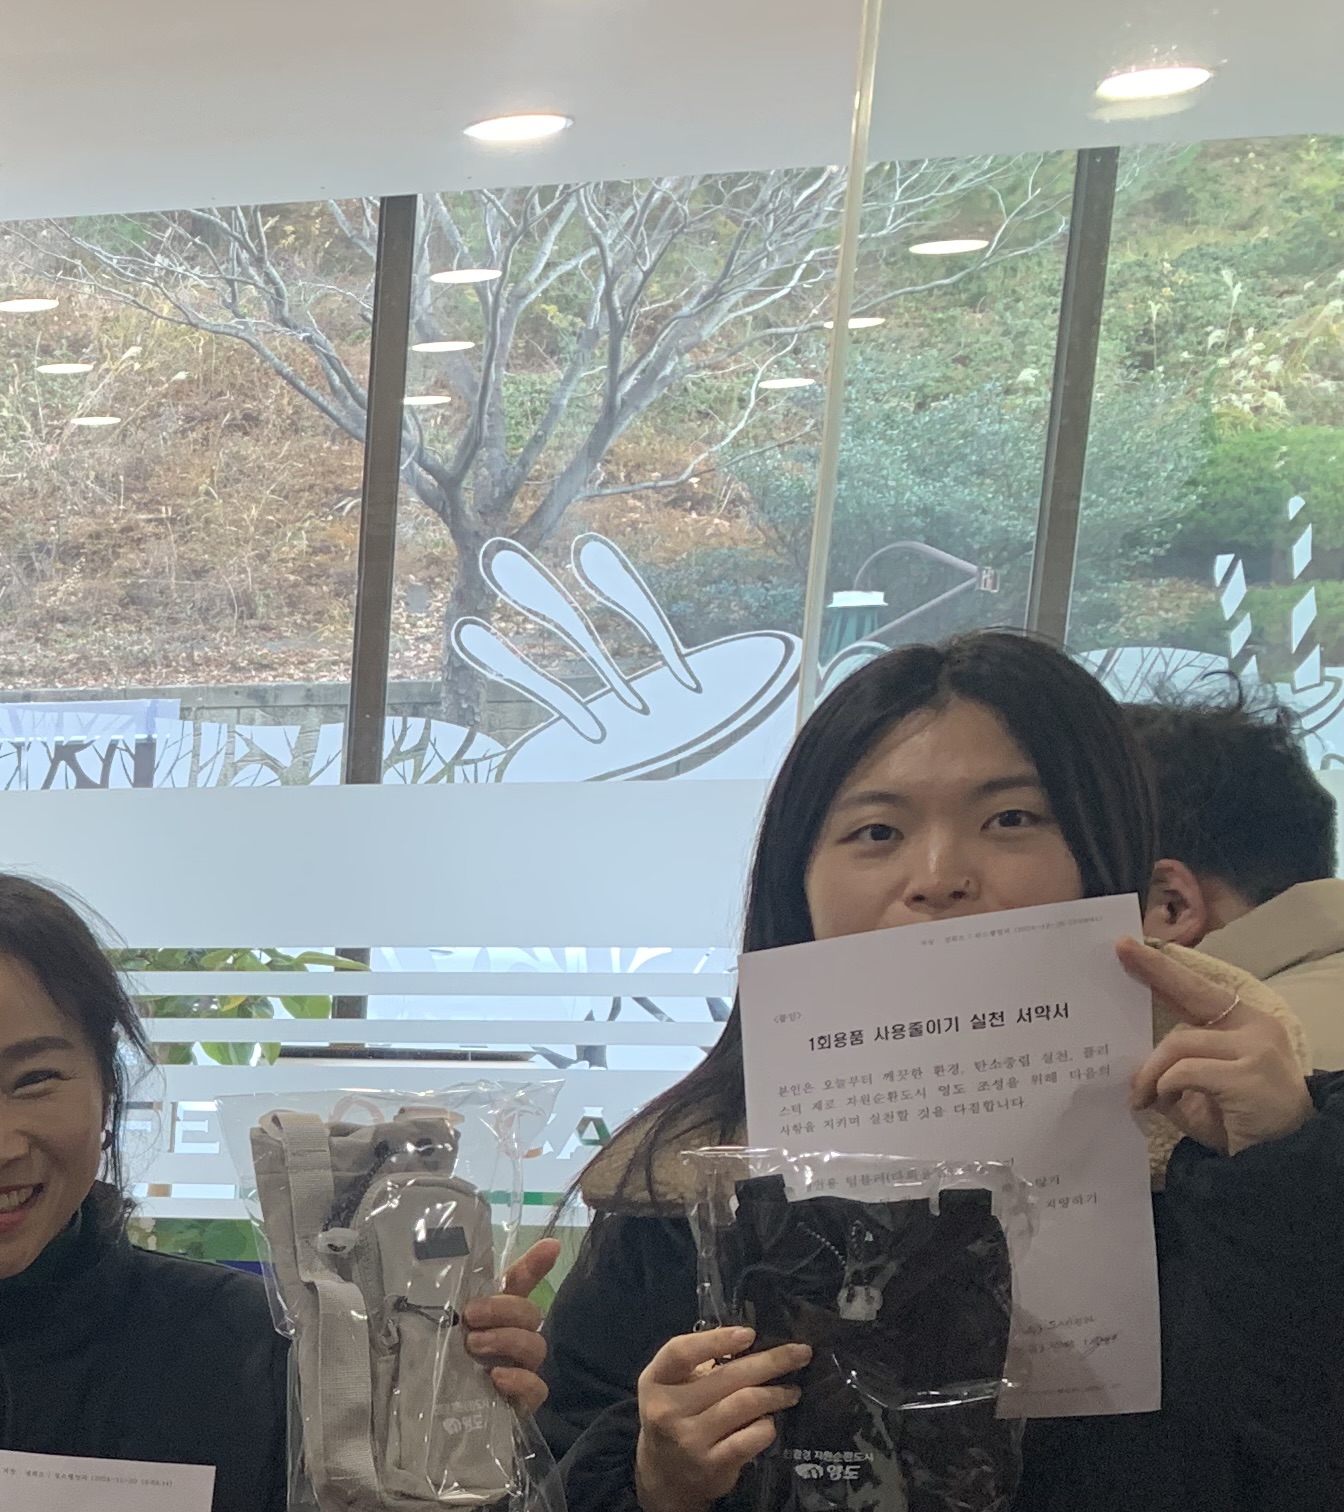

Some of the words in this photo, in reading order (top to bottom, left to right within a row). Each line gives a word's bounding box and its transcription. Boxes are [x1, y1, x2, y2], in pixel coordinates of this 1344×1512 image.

[809, 1030, 863, 1051] 1회용품
[874, 1016, 959, 1041] 사용줄이기
[970, 1011, 1004, 1029] 실천
[1017, 1003, 1068, 1023] 서약서
